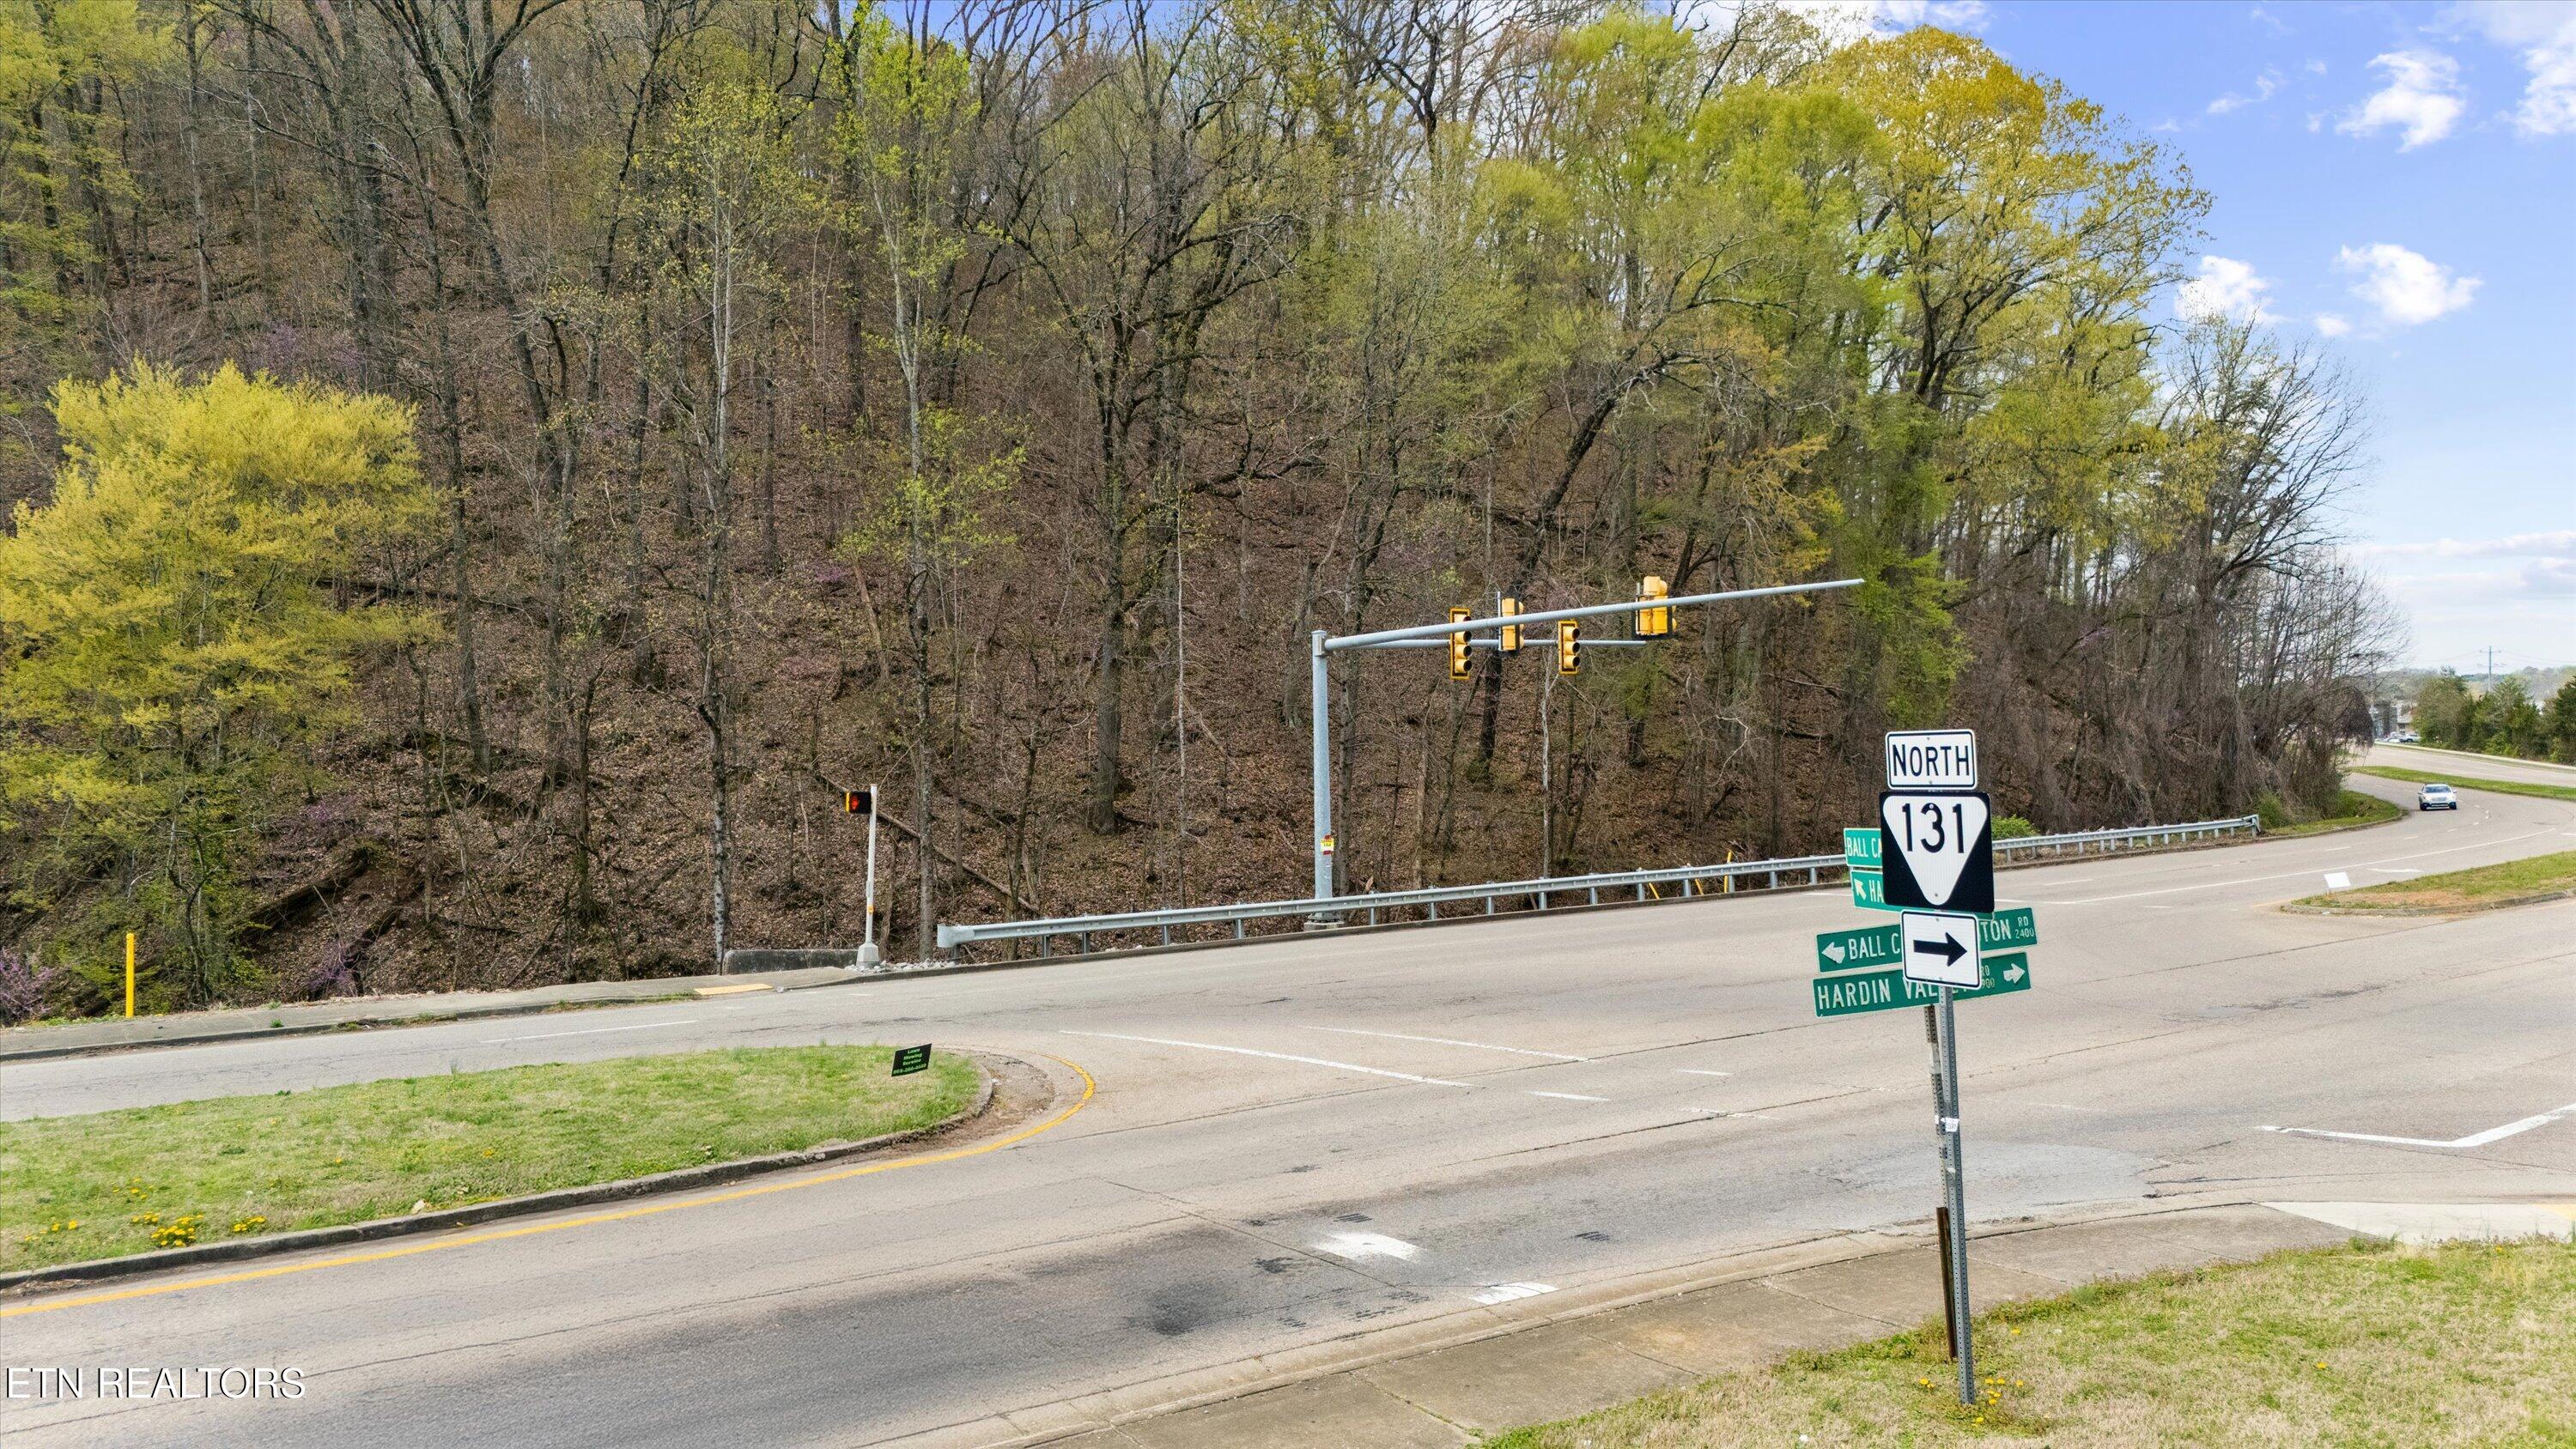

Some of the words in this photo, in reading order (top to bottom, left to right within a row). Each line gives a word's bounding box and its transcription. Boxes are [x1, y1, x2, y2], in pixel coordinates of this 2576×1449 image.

[1893, 744, 1970, 776] NORTH
[1902, 803, 1964, 854] 131
[1846, 837, 1868, 858] BALL
[2014, 928, 2035, 939] 2400
[2018, 916, 2029, 927] RD
[1848, 935, 1886, 961] BALL
[1817, 978, 1892, 1010] HARDIN
